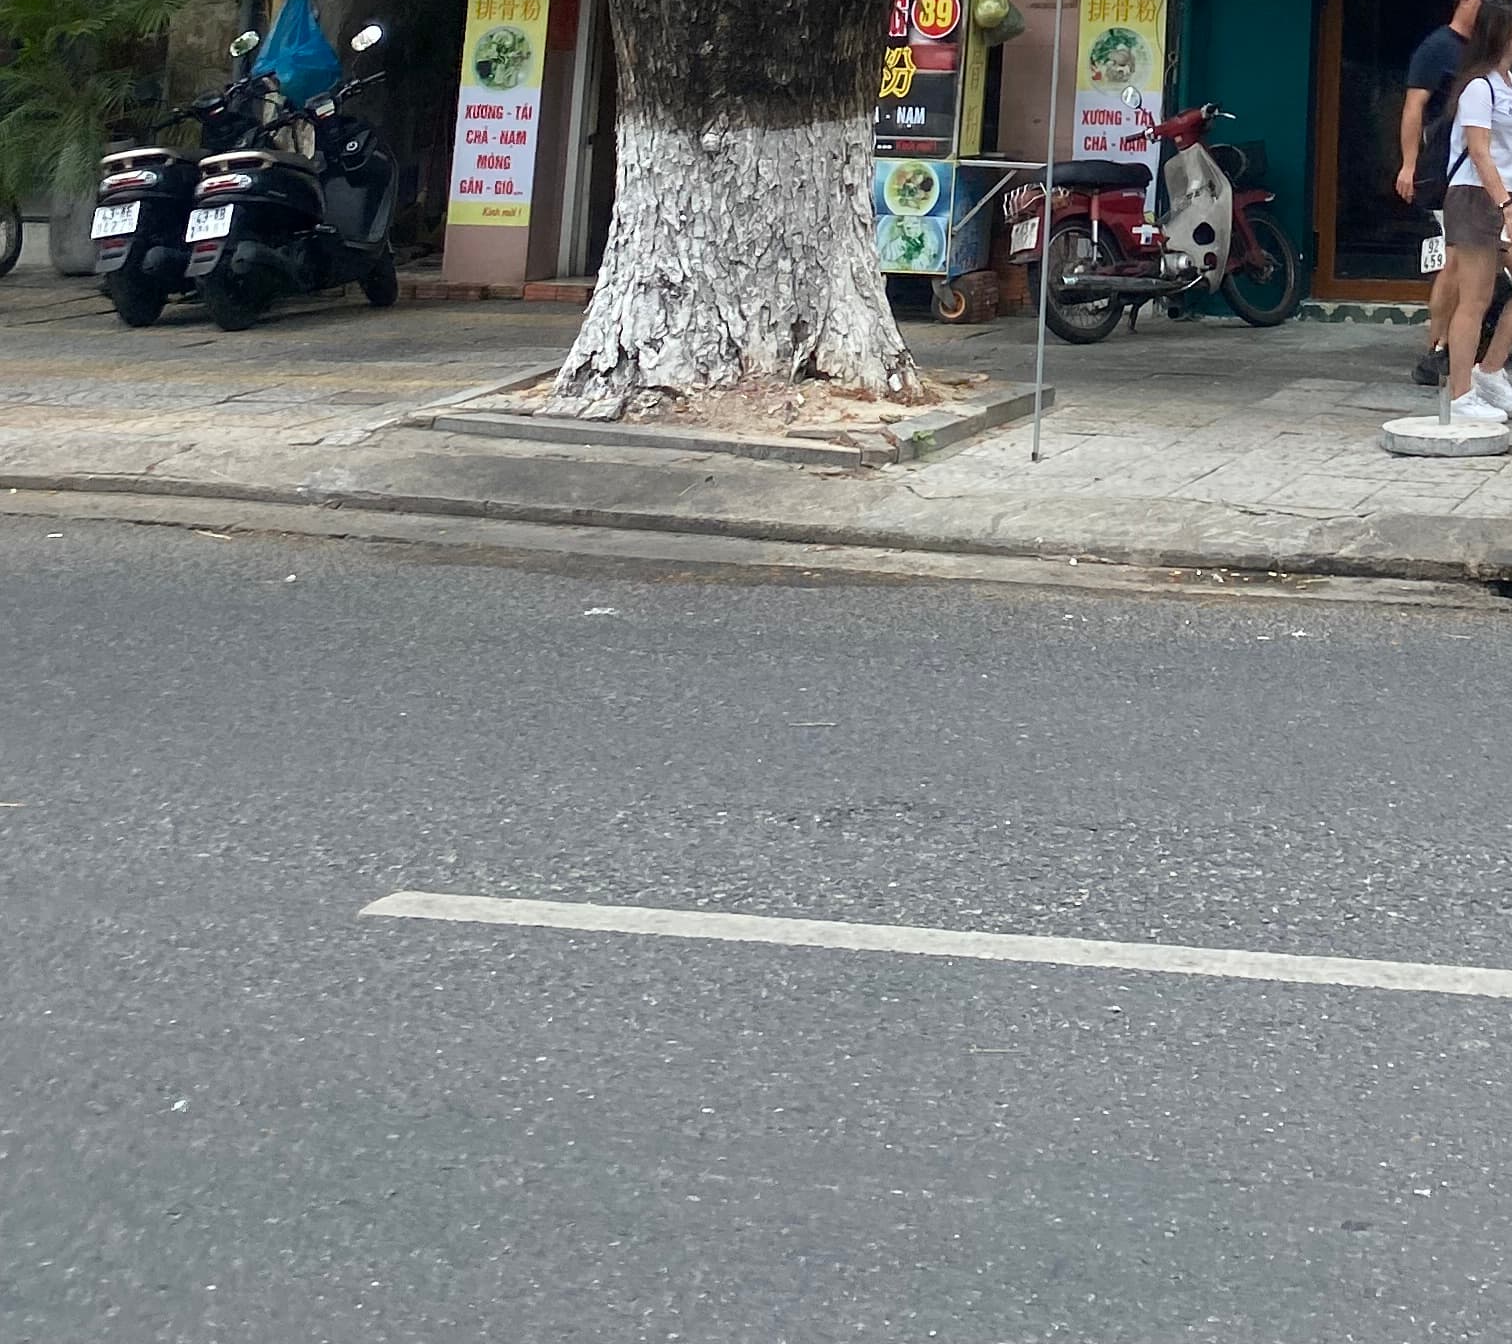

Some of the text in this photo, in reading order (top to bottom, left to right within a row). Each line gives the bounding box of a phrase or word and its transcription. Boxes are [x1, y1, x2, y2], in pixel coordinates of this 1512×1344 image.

[465, 103, 504, 120] XƯƠNG
[515, 102, 533, 120] TÁI
[896, 106, 926, 128] NẠM
[1082, 108, 1122, 126] XƯƠNG
[466, 126, 489, 145] CHẢ
[500, 130, 527, 149] NẠM
[1084, 131, 1107, 152] CHẢ
